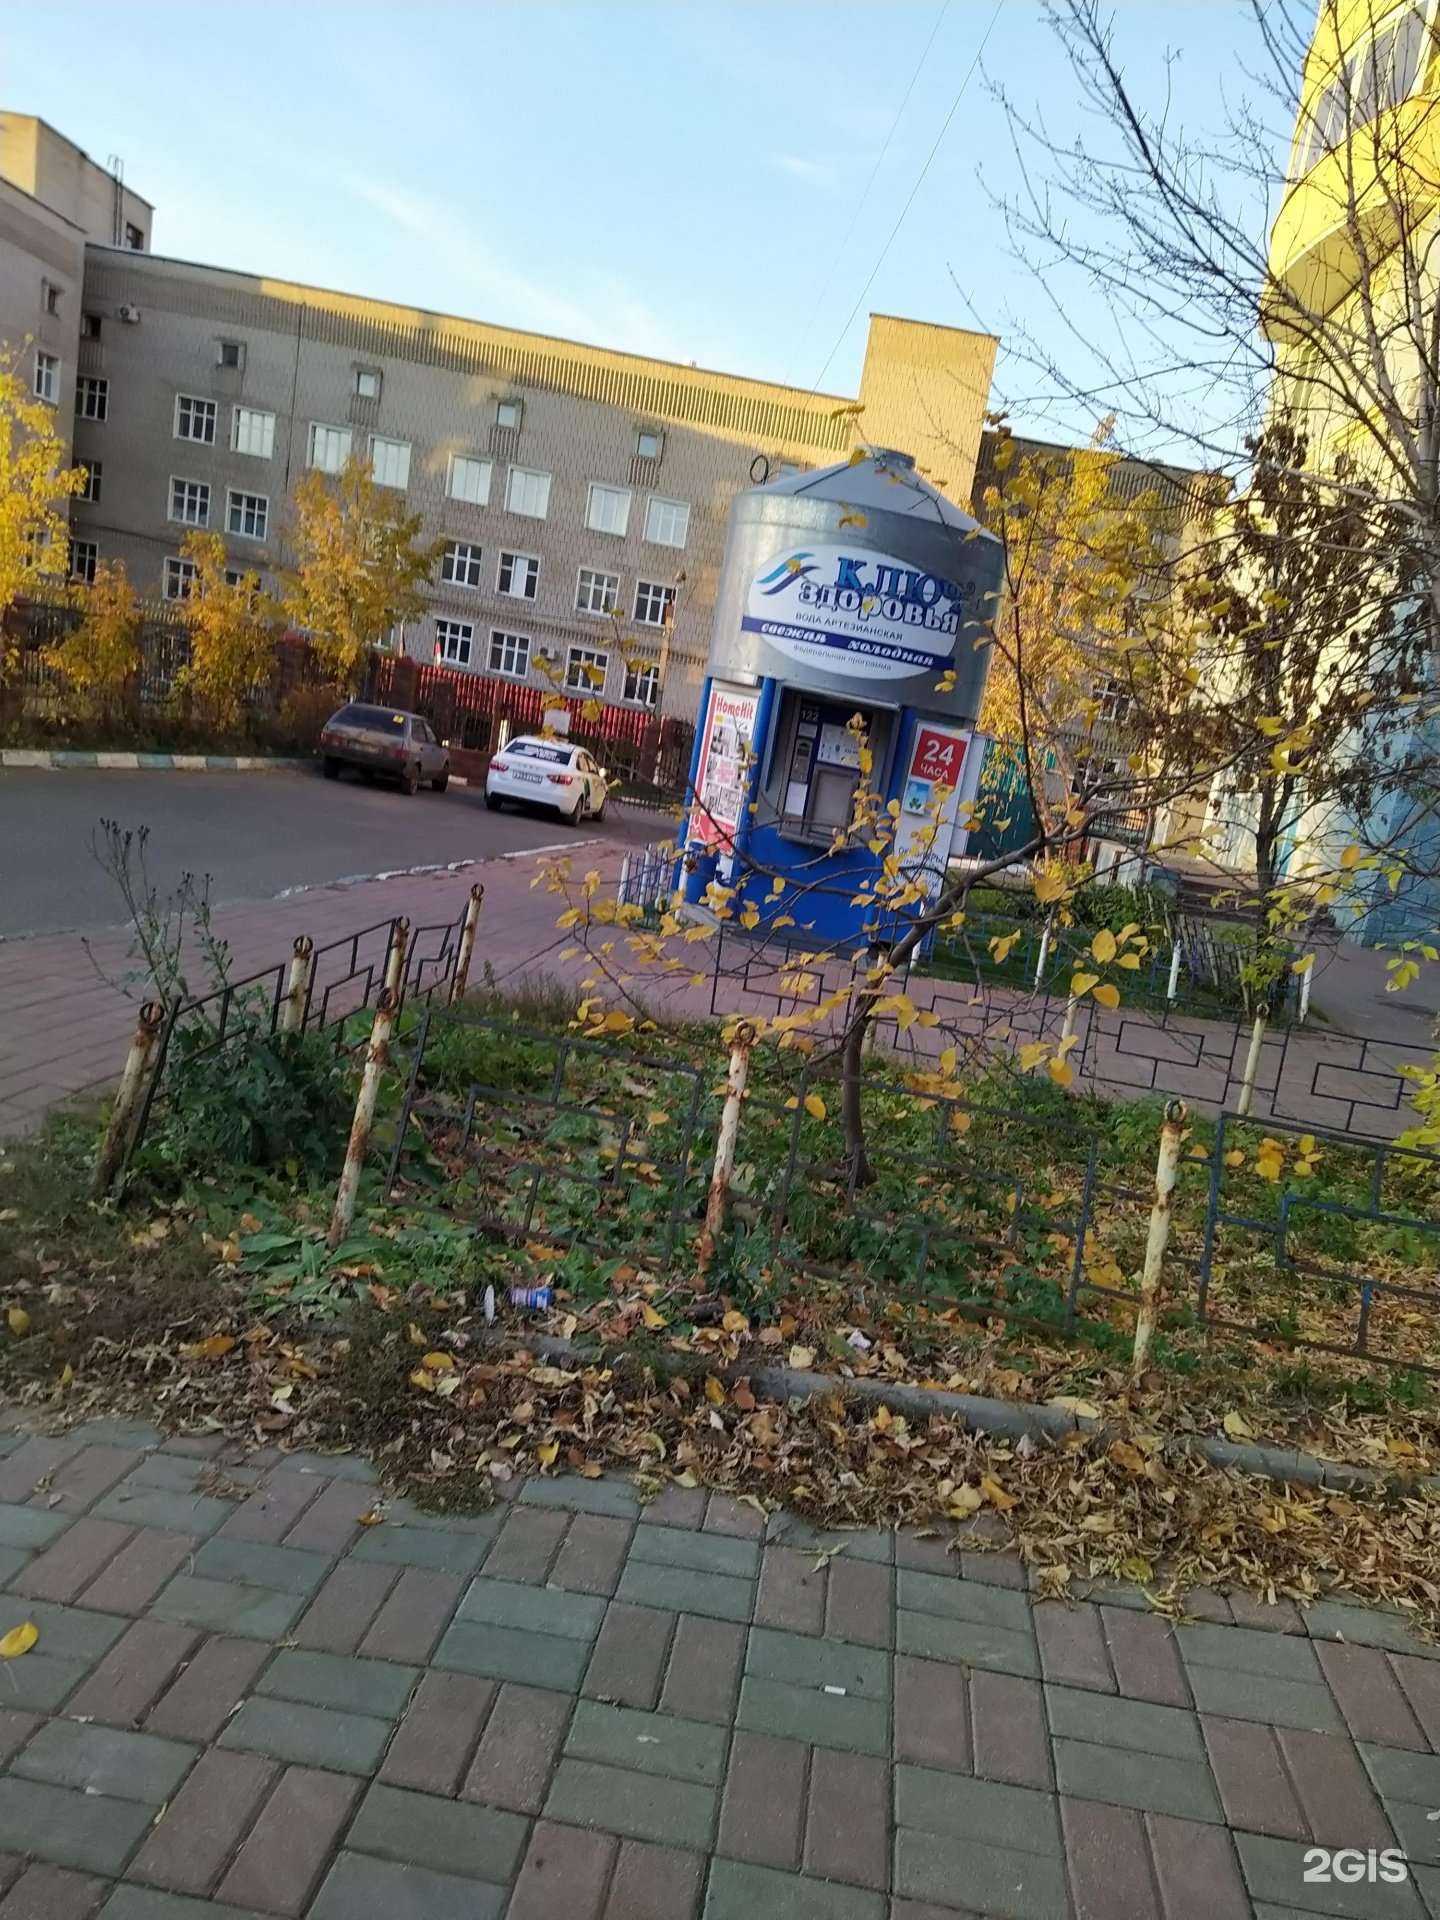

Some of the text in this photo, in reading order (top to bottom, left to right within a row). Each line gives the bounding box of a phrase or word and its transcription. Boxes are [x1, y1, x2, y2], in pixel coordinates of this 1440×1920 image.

[795, 612, 903, 641] ВОДА АРТЕЗИАНСКАЯ
[761, 623, 935, 667] свежая холодная
[717, 696, 754, 720] HomeHit
[924, 739, 954, 766] 24
[920, 763, 950, 780] ЧАСА
